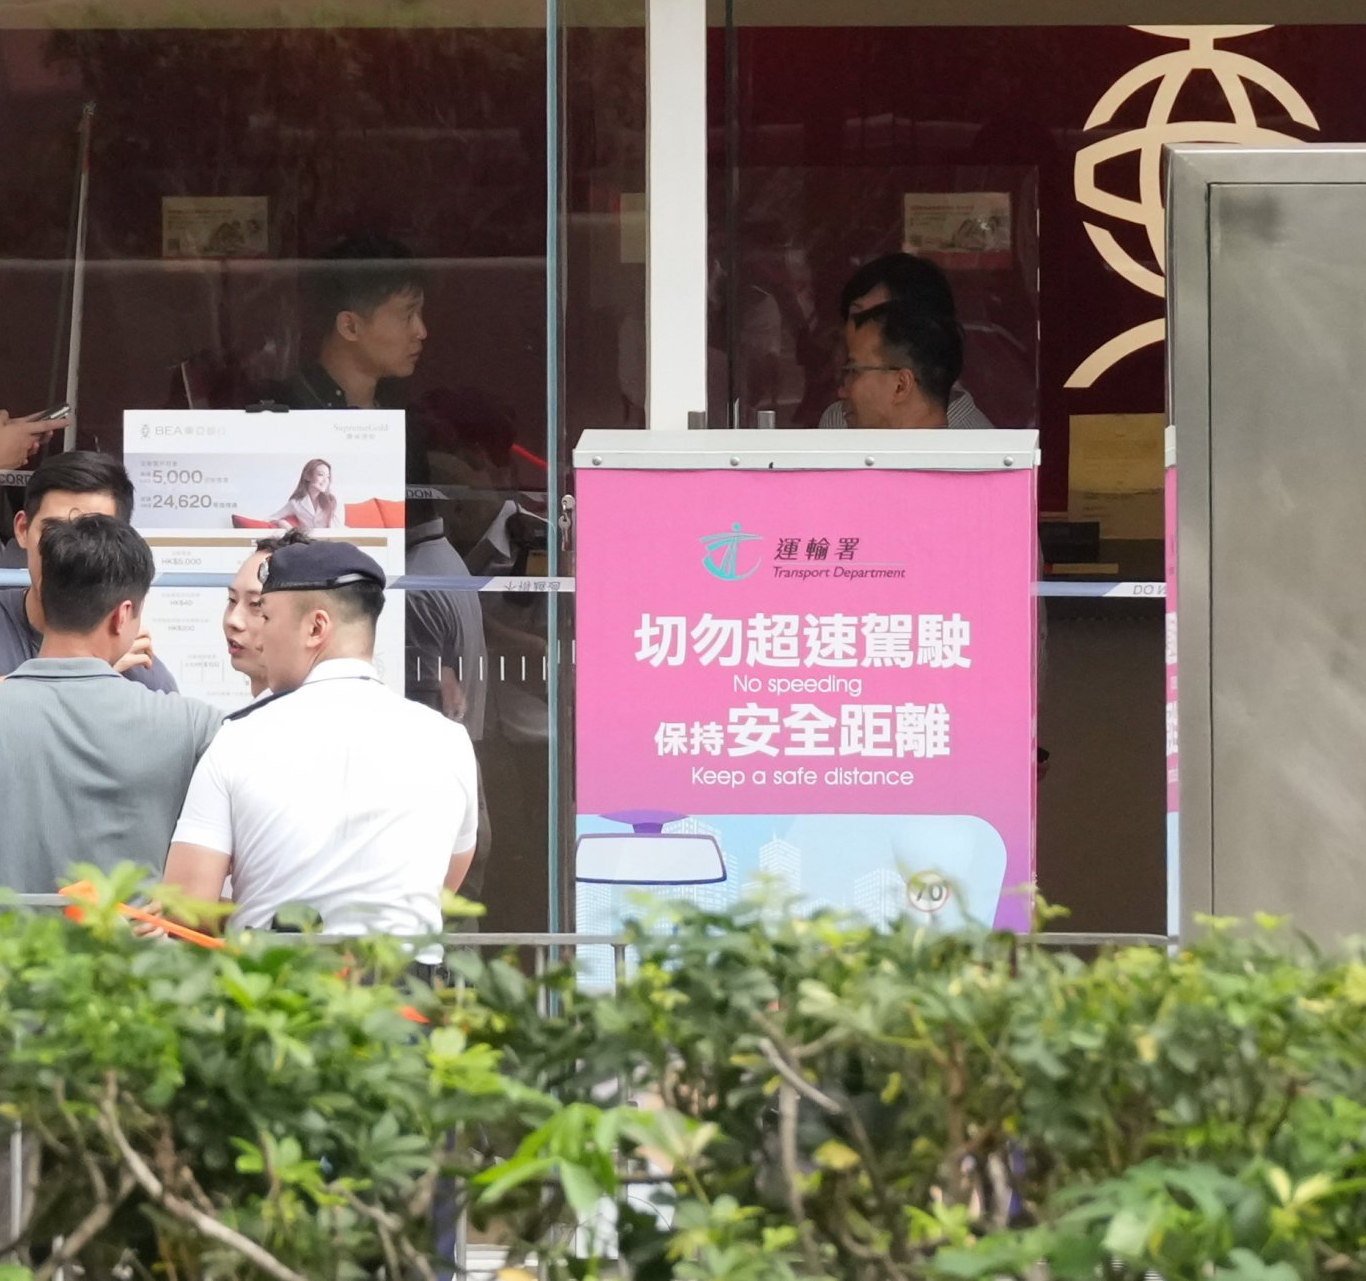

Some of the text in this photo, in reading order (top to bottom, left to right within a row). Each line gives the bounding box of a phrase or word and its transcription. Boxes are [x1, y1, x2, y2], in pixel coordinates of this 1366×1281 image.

[155, 425, 183, 436] BEA
[152, 470, 203, 485] 5,000
[152, 495, 212, 510] 24,620
[773, 537, 860, 561] 運輸署
[772, 565, 907, 581] Transport Department
[634, 612, 972, 669] 切勿超速駕駛
[733, 674, 862, 697] No speeding
[653, 702, 951, 759] 保持安全距離
[691, 766, 915, 788] Keep a safe distance
